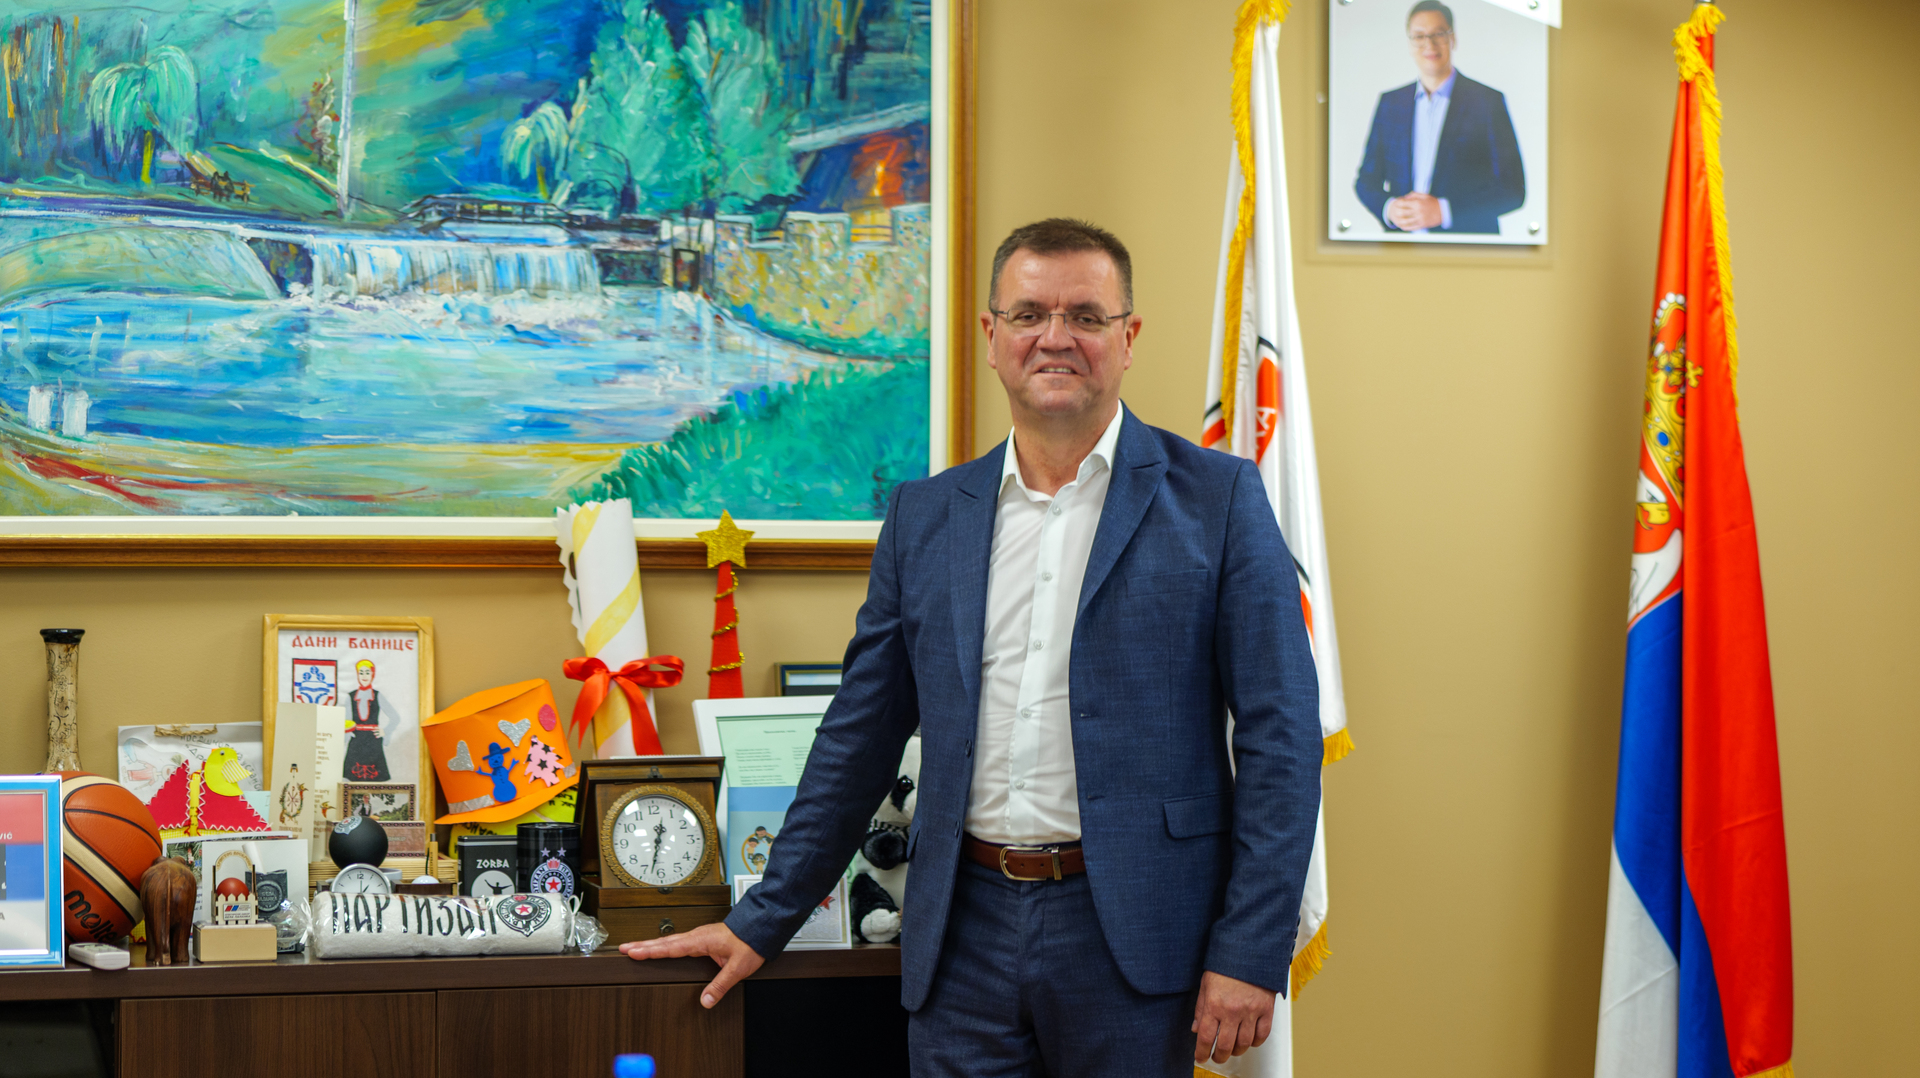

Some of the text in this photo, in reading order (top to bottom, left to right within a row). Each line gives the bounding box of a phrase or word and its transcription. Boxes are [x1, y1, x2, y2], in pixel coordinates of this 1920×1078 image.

[292, 635, 415, 651] ДАНИ БАНИЦЕ
[648, 805, 660, 815] 12
[634, 811, 644, 821] 11
[623, 823, 636, 833] 10
[679, 820, 688, 829] 2
[620, 839, 629, 849] 9
[686, 834, 695, 845] 3
[629, 854, 638, 864] 8
[682, 851, 691, 861] 4
[476, 859, 510, 869] ZORBA
[640, 864, 649, 874] 7
[673, 862, 682, 873] 5
[656, 868, 666, 879] 6
[65, 890, 118, 942] molte
